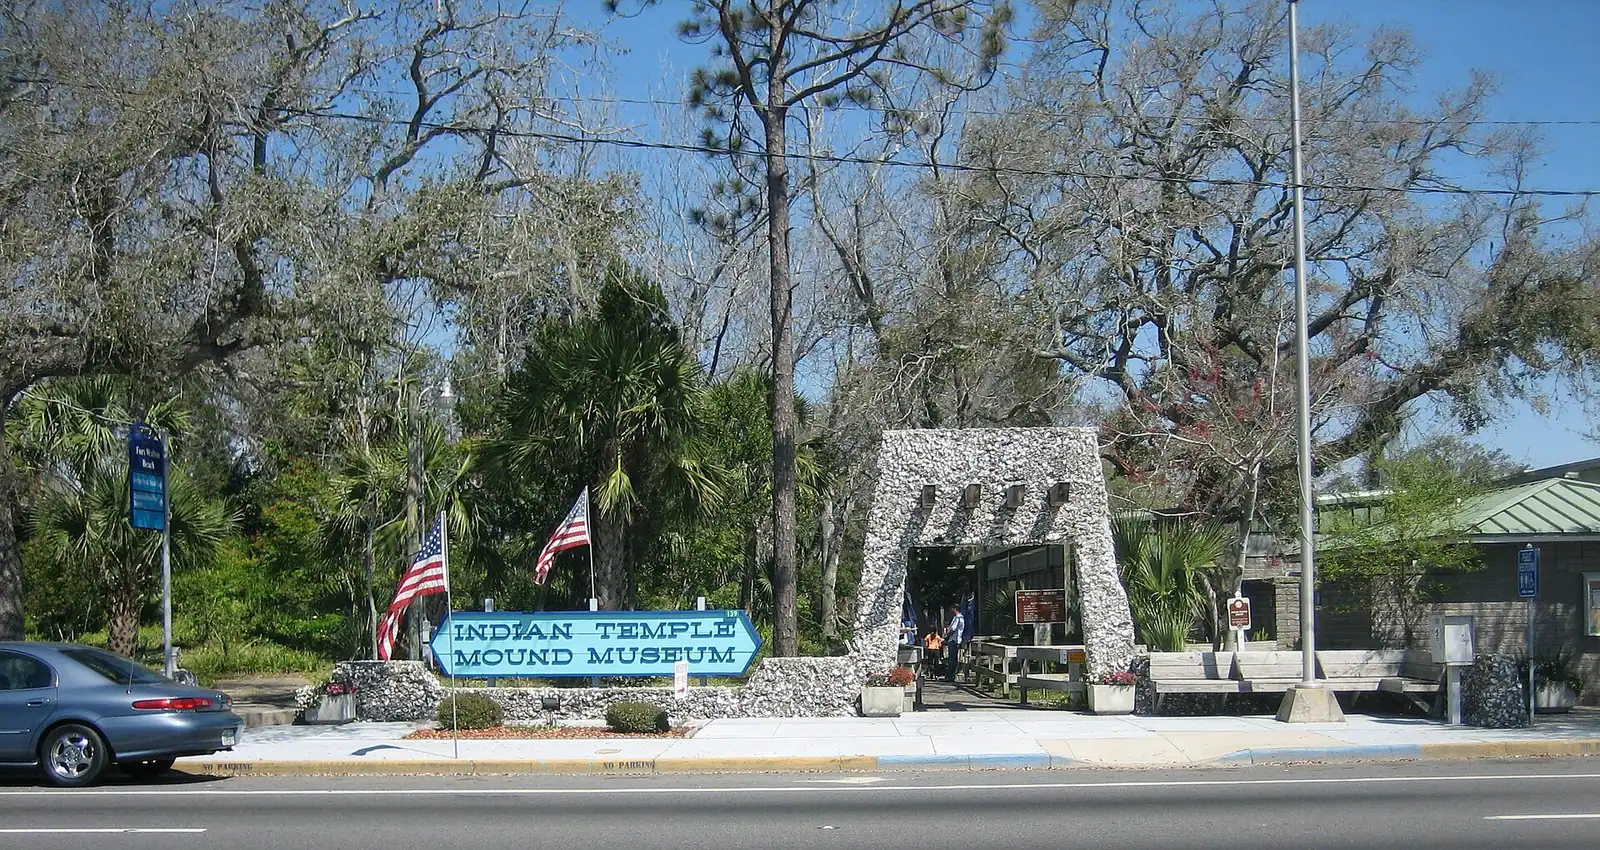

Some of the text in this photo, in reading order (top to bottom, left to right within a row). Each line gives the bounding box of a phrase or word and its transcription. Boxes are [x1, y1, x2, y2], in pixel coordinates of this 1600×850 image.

[454, 621, 737, 641] INDIAN TEMPLE
[454, 646, 736, 666] MOUND MUSEUM
